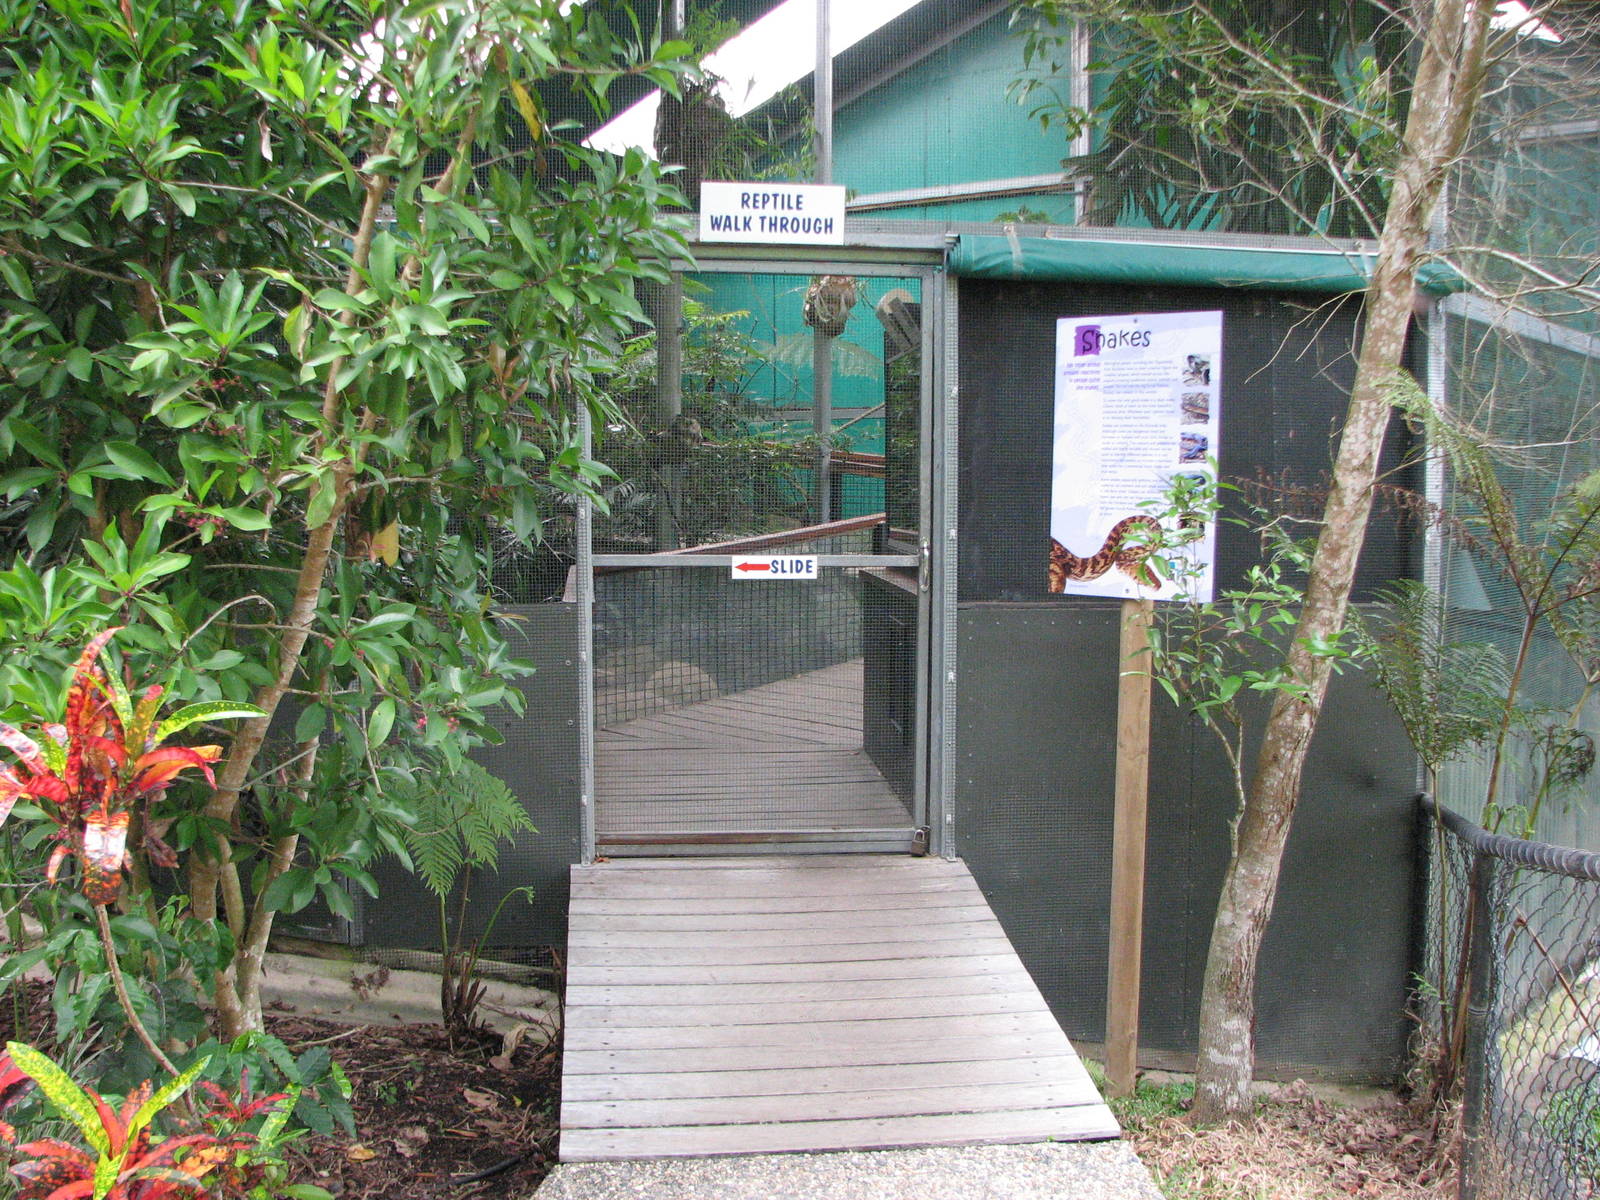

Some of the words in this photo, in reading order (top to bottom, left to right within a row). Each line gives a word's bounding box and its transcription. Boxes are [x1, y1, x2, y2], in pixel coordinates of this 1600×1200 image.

[741, 192, 803, 210] REPTILE
[710, 215, 752, 232] WALK
[759, 216, 833, 234] THROUGH
[1082, 329, 1152, 353] Snakes
[771, 559, 813, 574] SLIDE
